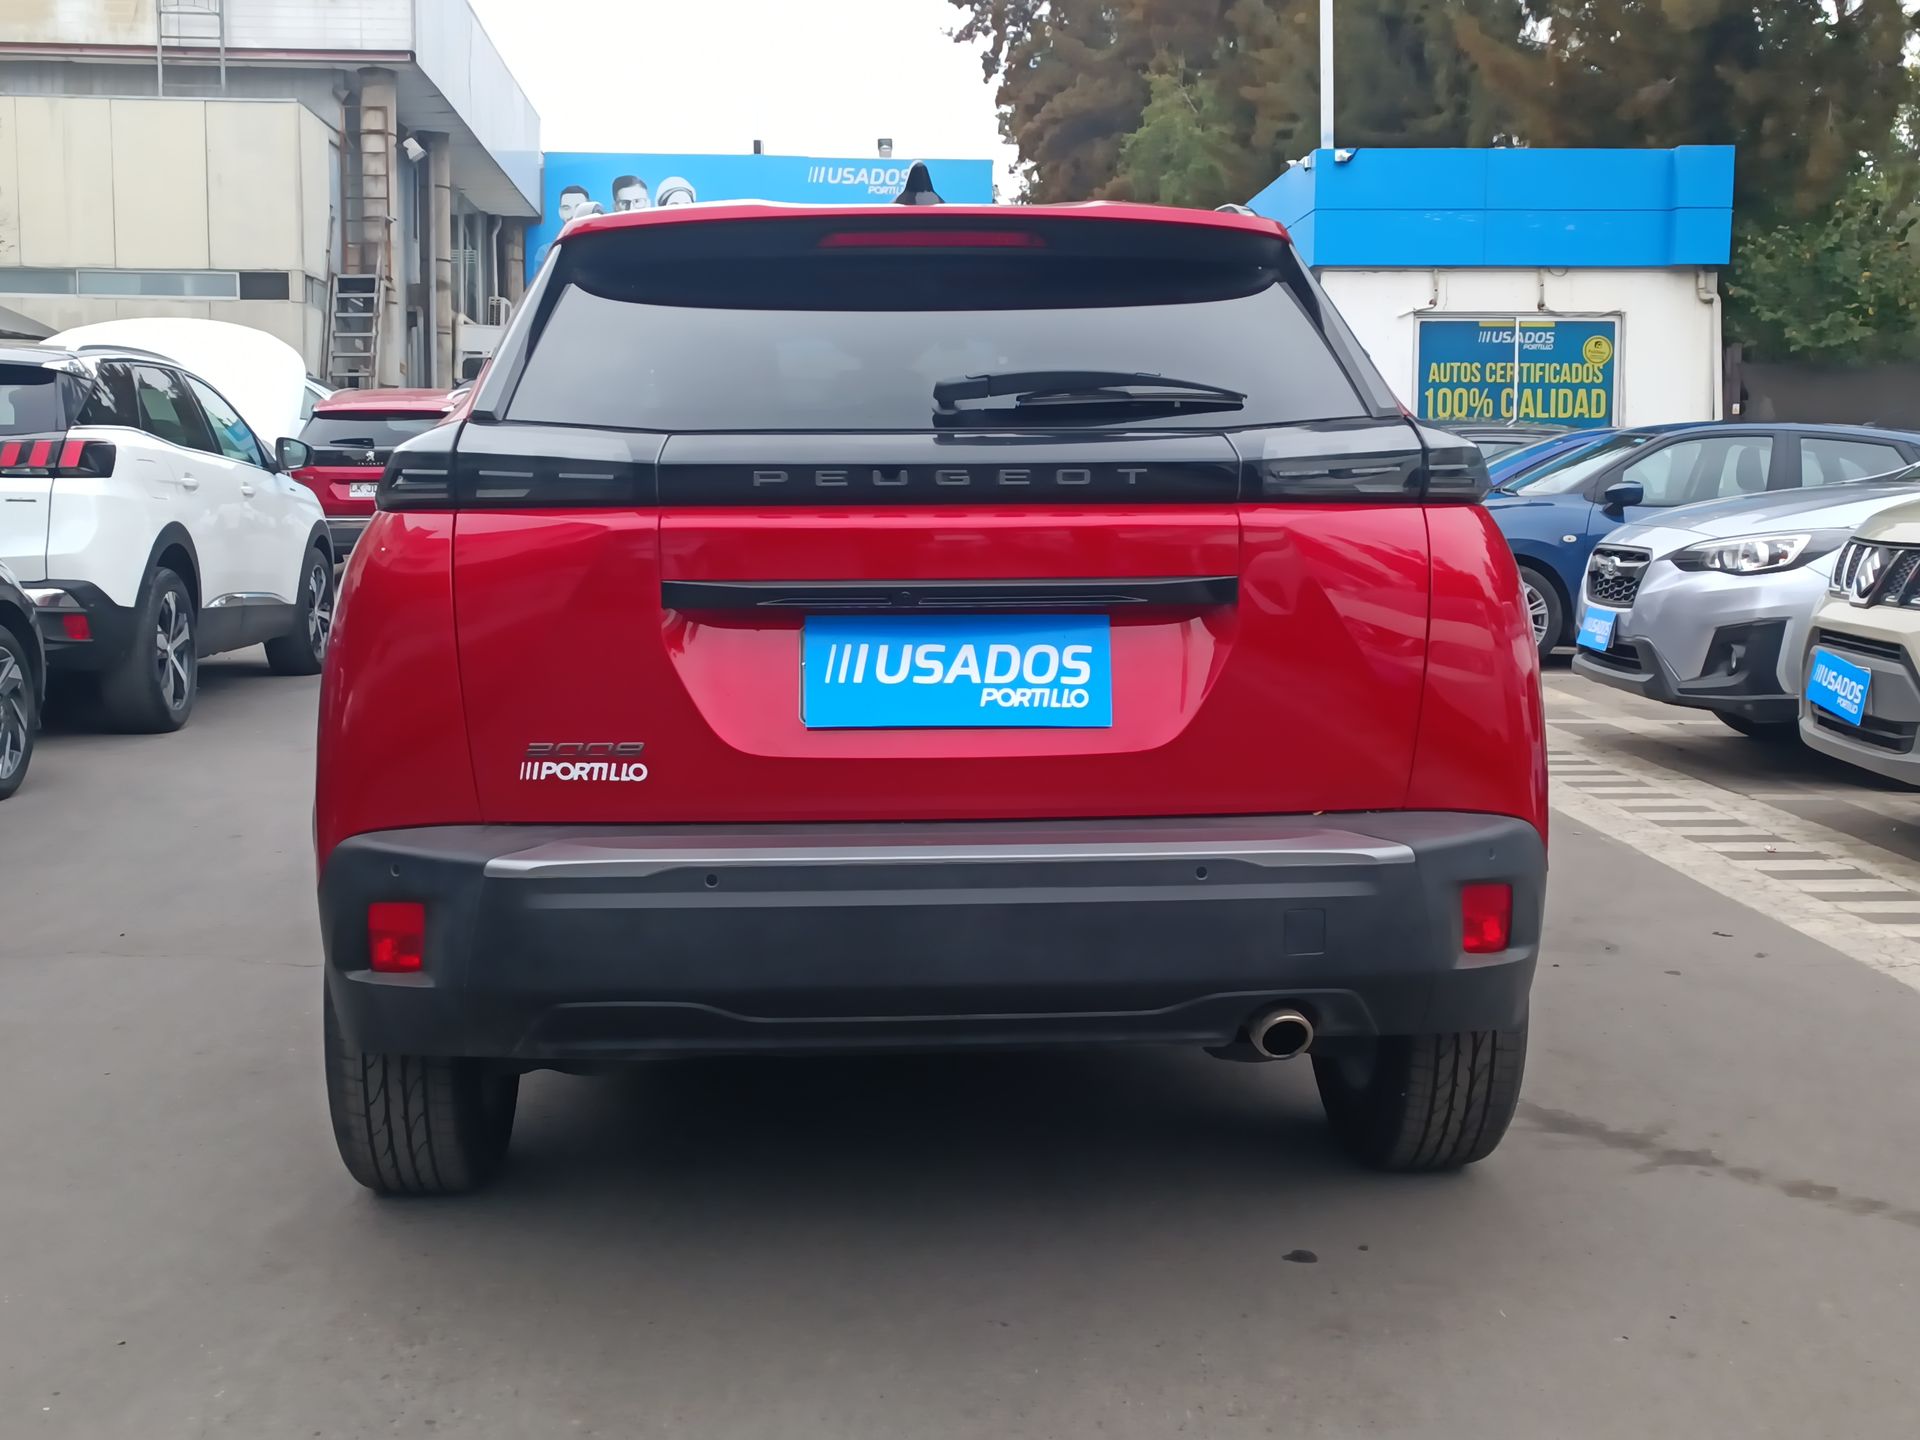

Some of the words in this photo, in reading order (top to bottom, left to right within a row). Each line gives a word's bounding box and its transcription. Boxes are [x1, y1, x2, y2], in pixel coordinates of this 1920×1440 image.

[1428, 362, 1482, 383] AUTOS
[1425, 387, 1494, 420] 100%
[1501, 387, 1607, 419] CALIDAD
[752, 468, 1149, 487] PEUGEOT
[875, 644, 1093, 685] USADOS
[1821, 666, 1865, 704] USADOS
[980, 687, 1090, 708] PORTILLO
[526, 741, 645, 757] 2008
[540, 761, 649, 782] PORTILLO
